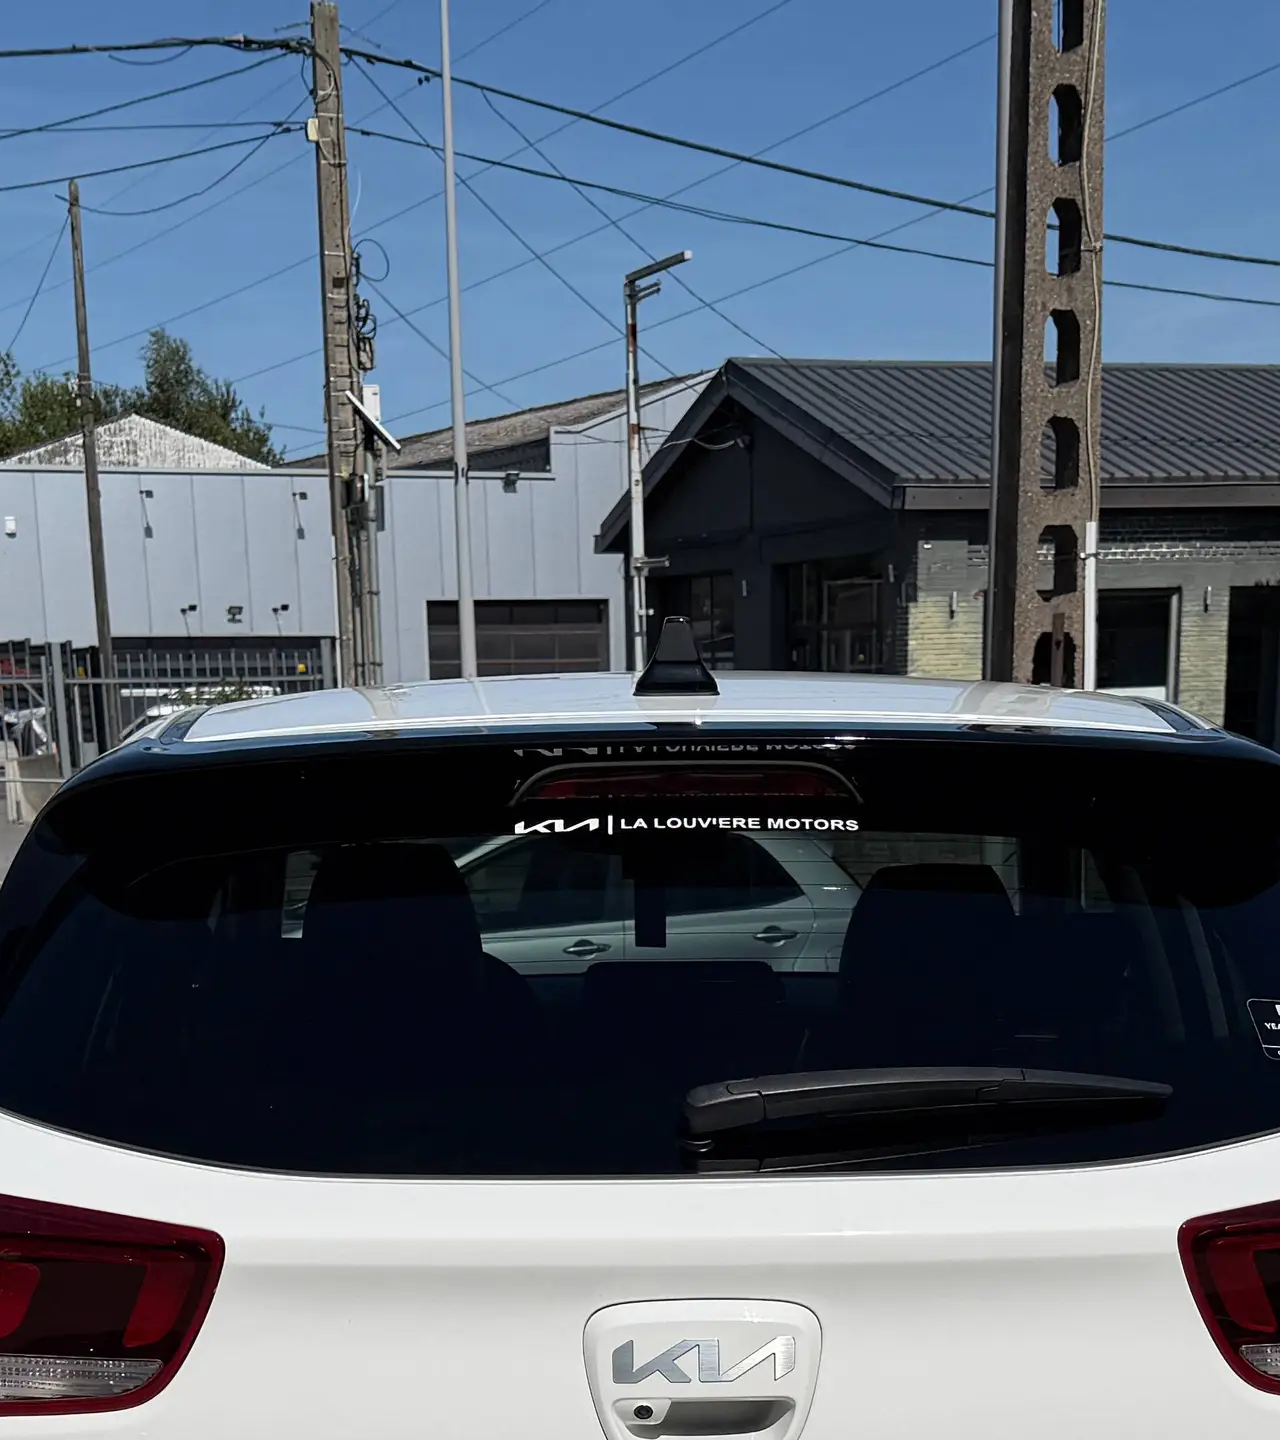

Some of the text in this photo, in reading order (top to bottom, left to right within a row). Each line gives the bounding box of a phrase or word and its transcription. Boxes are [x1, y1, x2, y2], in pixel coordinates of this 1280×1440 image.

[514, 818, 600, 835] KIA
[620, 817, 648, 829] LA
[767, 817, 859, 831] MOTORS
[612, 1335, 796, 1384] KIA
